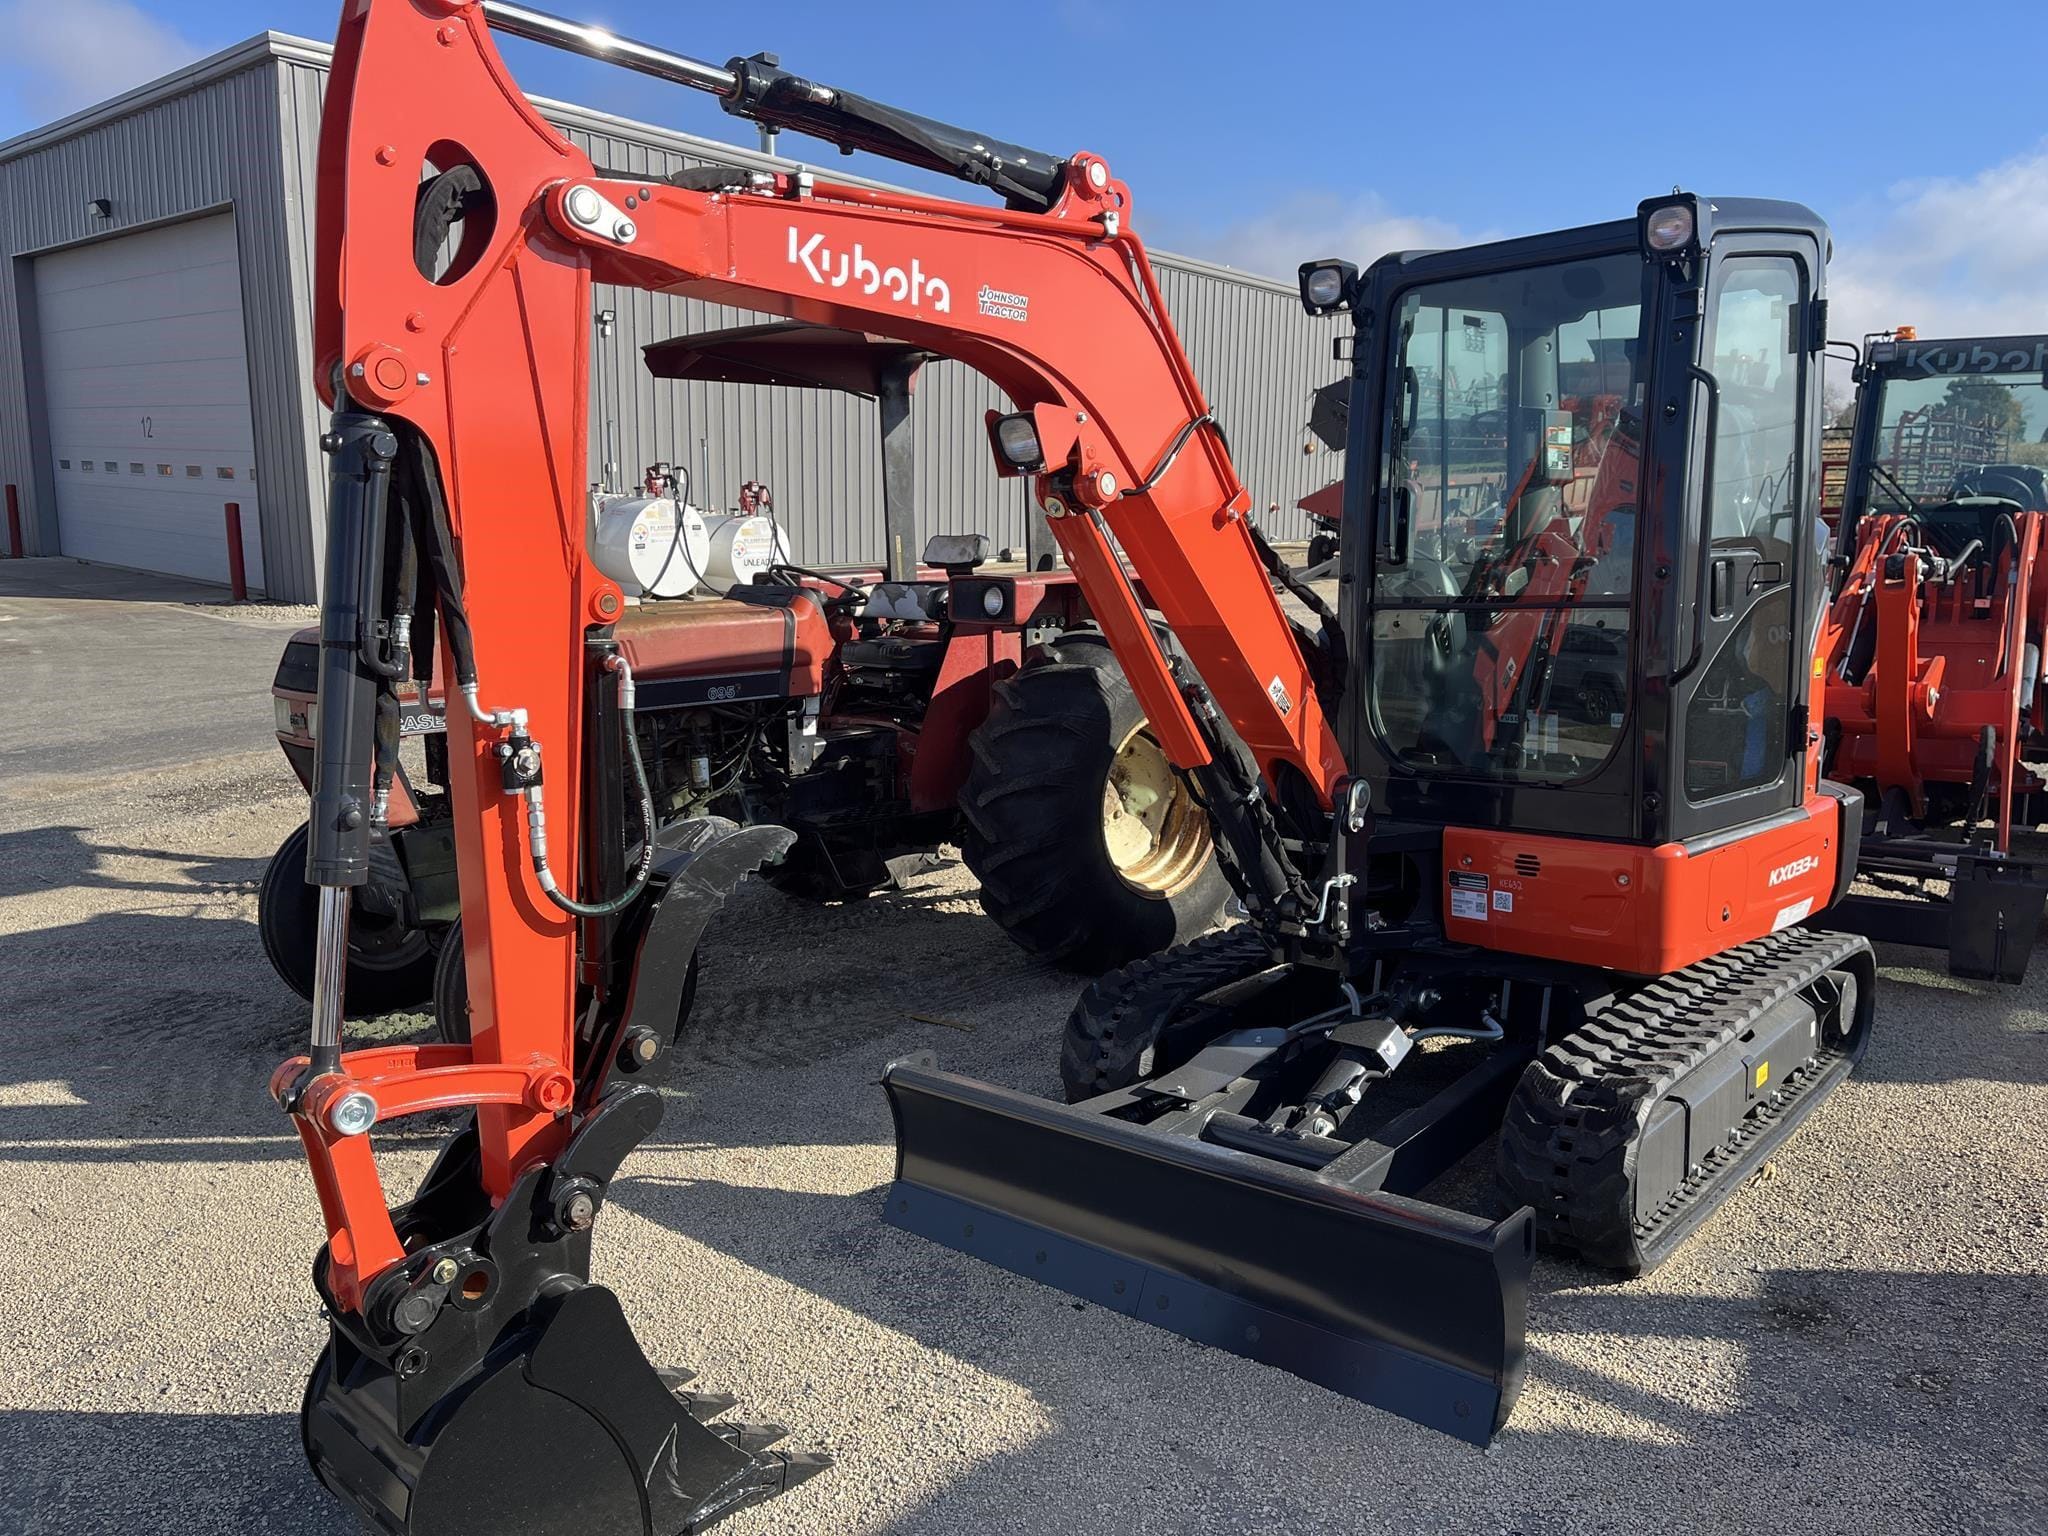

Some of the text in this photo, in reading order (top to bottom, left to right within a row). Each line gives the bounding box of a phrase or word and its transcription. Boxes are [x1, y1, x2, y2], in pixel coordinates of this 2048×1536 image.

[788, 226, 951, 313] Kubota
[978, 286, 1028, 307] JOHNSON
[979, 299, 1027, 320] TRACTOR
[140, 415, 153, 438] 12
[707, 685, 736, 700] 695
[640, 798, 651, 826] Winner
[1768, 855, 1819, 888] KX033-4
